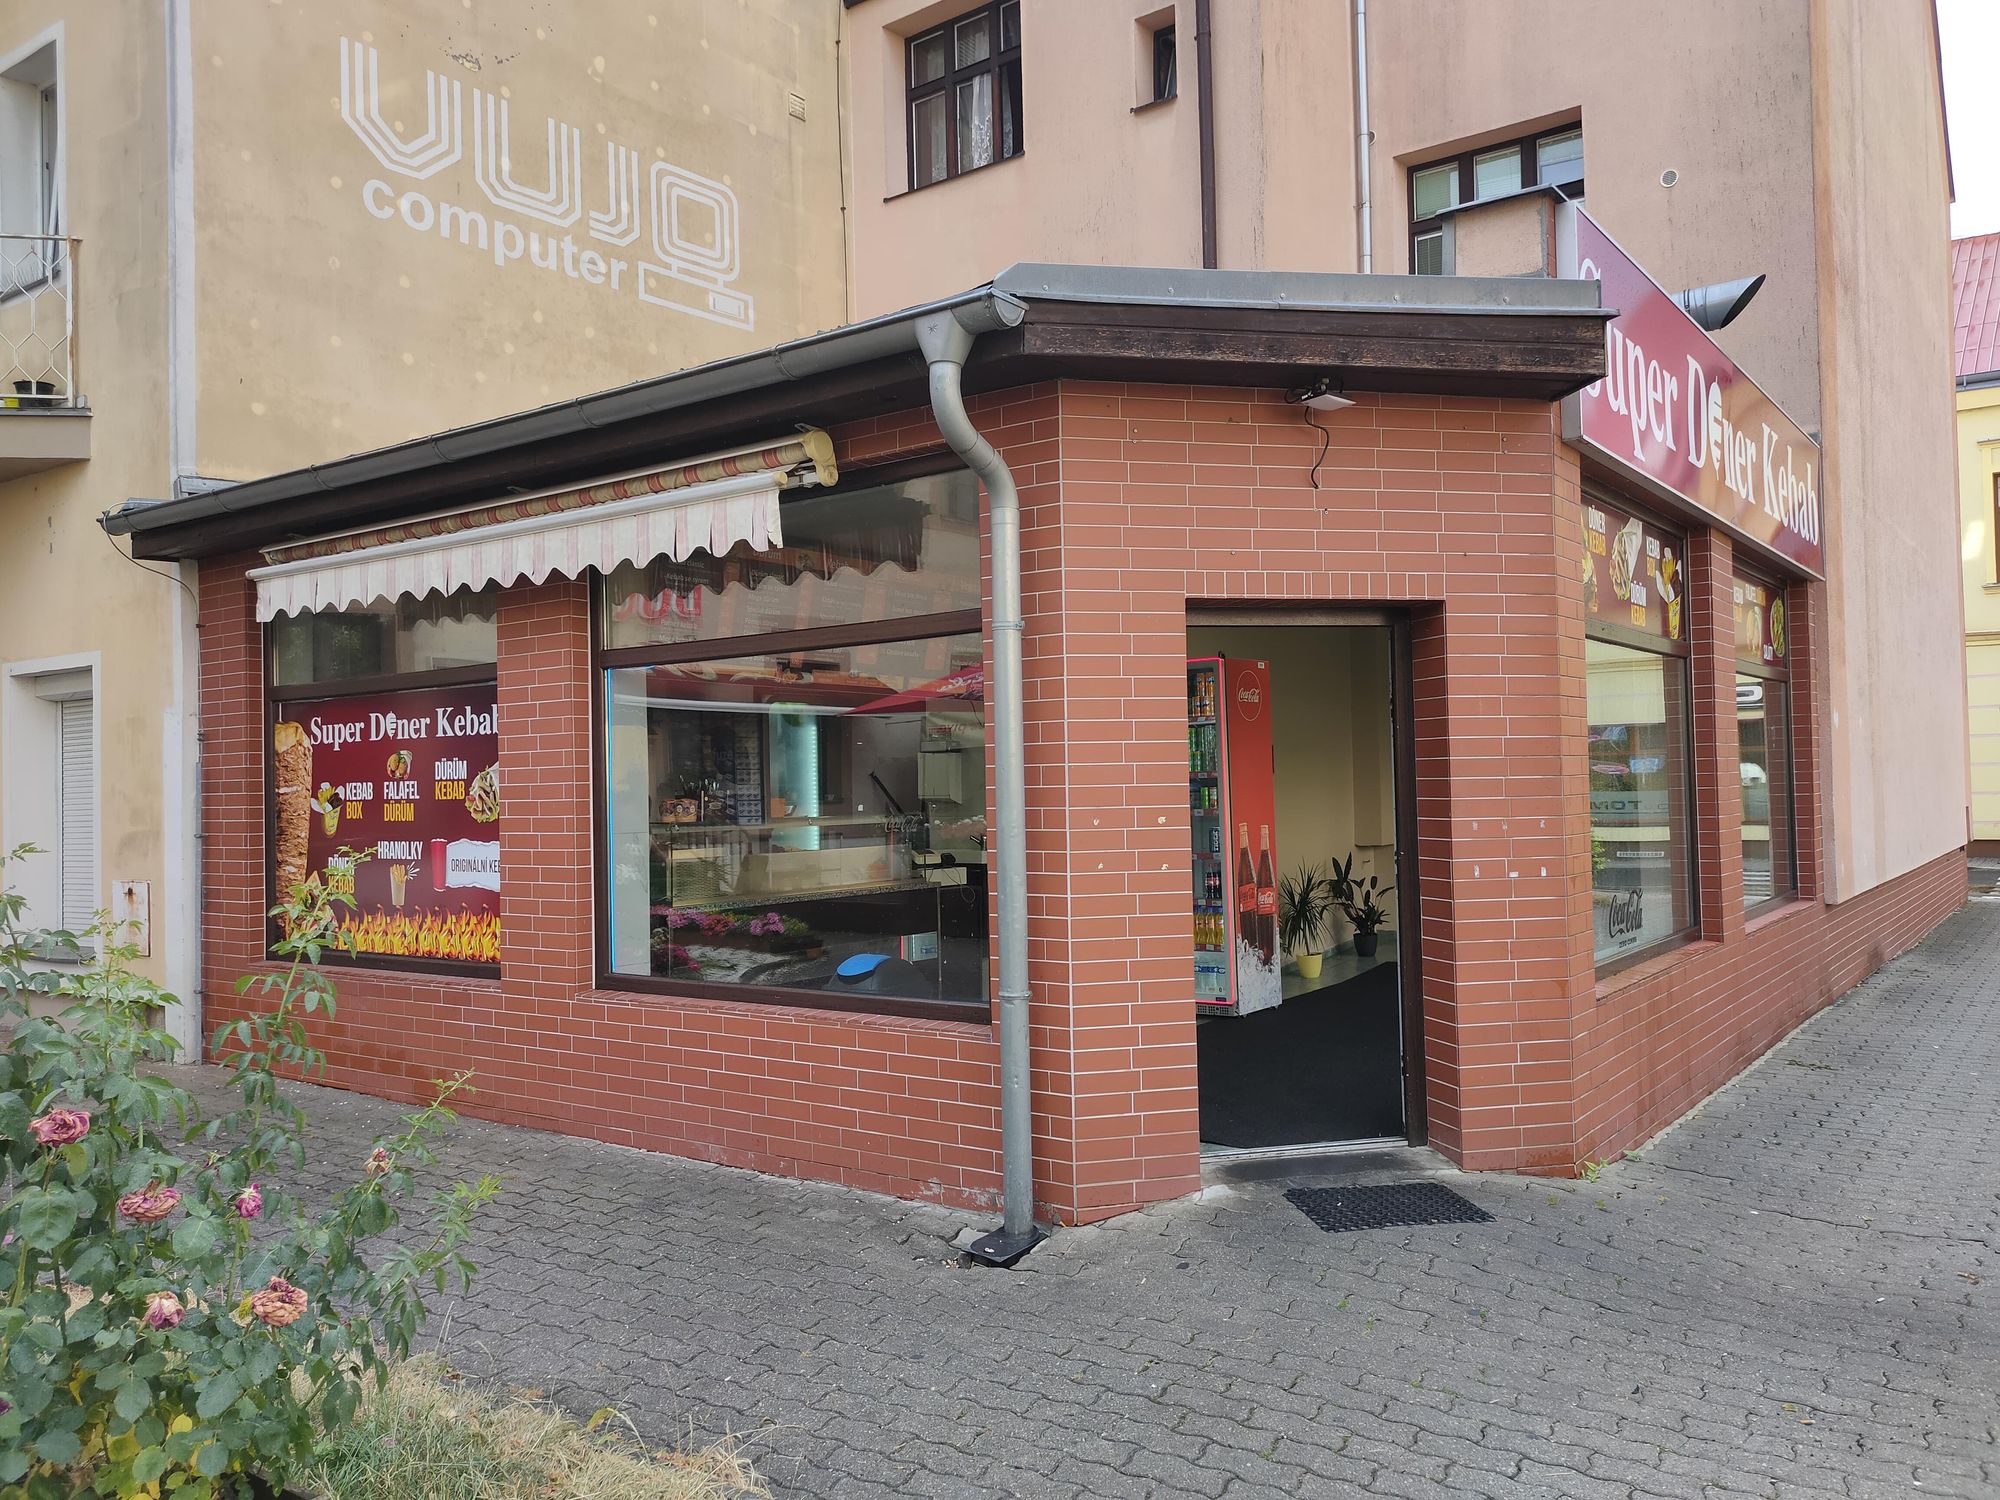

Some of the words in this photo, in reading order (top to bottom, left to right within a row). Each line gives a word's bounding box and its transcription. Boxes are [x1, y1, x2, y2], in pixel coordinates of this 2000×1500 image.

[362, 179, 628, 290] computer
[1579, 258, 1678, 462] uper
[1761, 423, 1820, 547] Kebab
[1238, 688, 1261, 703] Coca-Cola
[310, 716, 365, 751] Super
[435, 758, 467, 780] DÜRÜM
[346, 781, 373, 801] KEBAB
[383, 781, 420, 800] FALAFEL
[435, 780, 466, 800] KEBAB
[346, 801, 363, 820] BOX
[383, 801, 415, 822] DÜRÜM
[377, 840, 423, 860] HRANOLKY
[451, 857, 488, 873] ORIGINÁLNÍ
